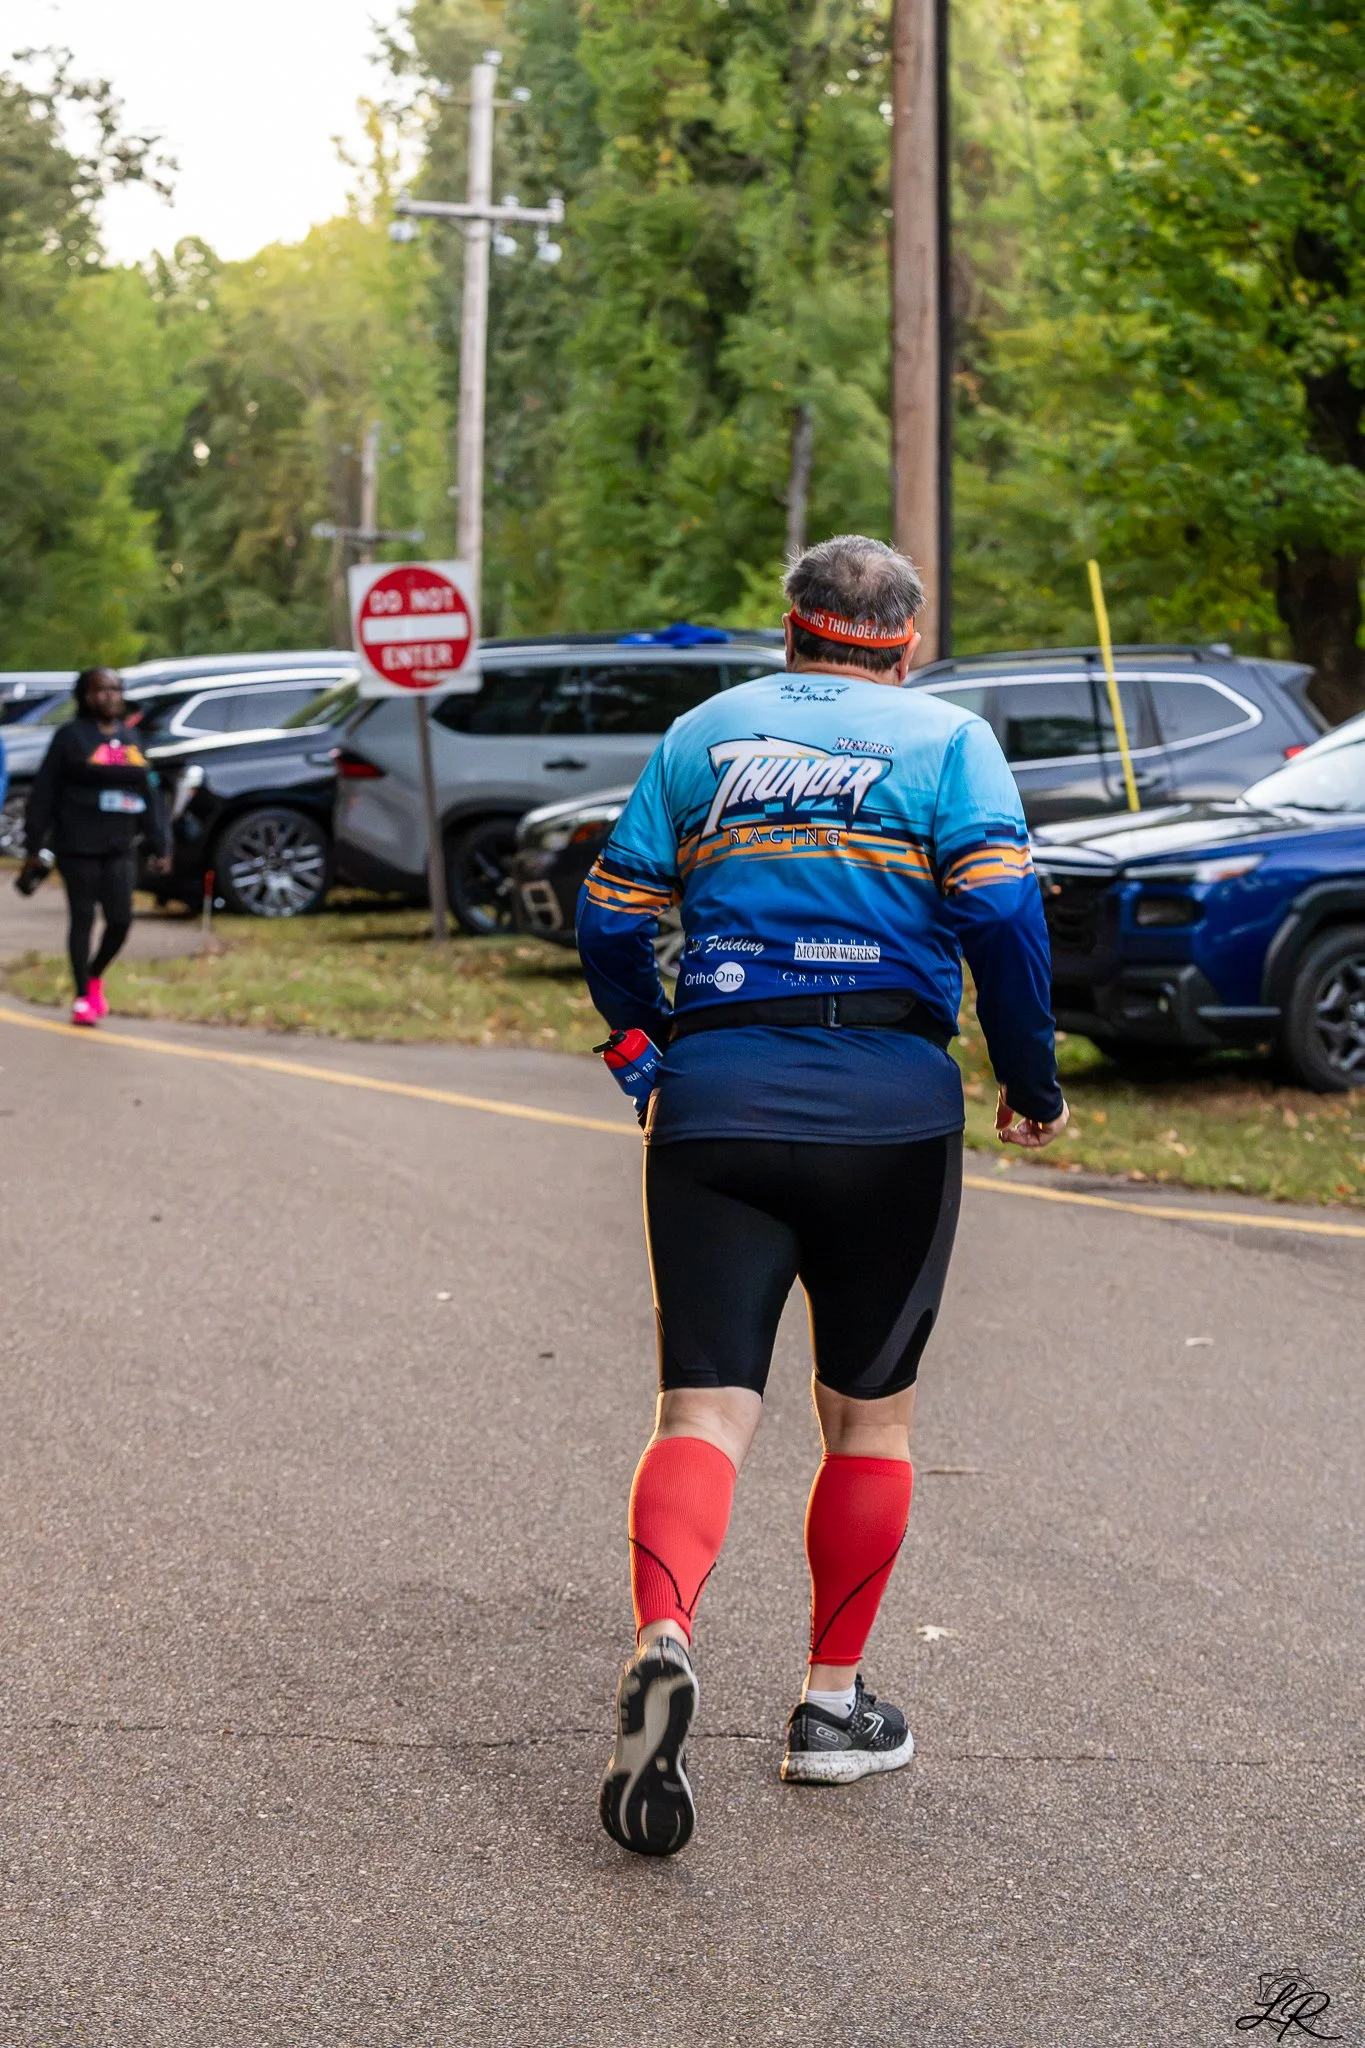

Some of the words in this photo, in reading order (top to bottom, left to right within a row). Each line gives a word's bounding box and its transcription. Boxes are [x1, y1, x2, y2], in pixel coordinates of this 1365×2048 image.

[369, 589, 403, 614] DO
[410, 586, 454, 611] NOT
[828, 616, 878, 639] THUNDER
[381, 643, 453, 670] ENTER
[701, 733, 892, 839] THUNDER
[728, 827, 841, 845] RACING
[705, 935, 765, 956] Fielding
[797, 945, 838, 960] MOTOR
[839, 947, 879, 961] WERKS
[684, 970, 744, 987] OrthoOne
[782, 971, 856, 986] CREWS
[642, 1058, 657, 1073] 13.1
